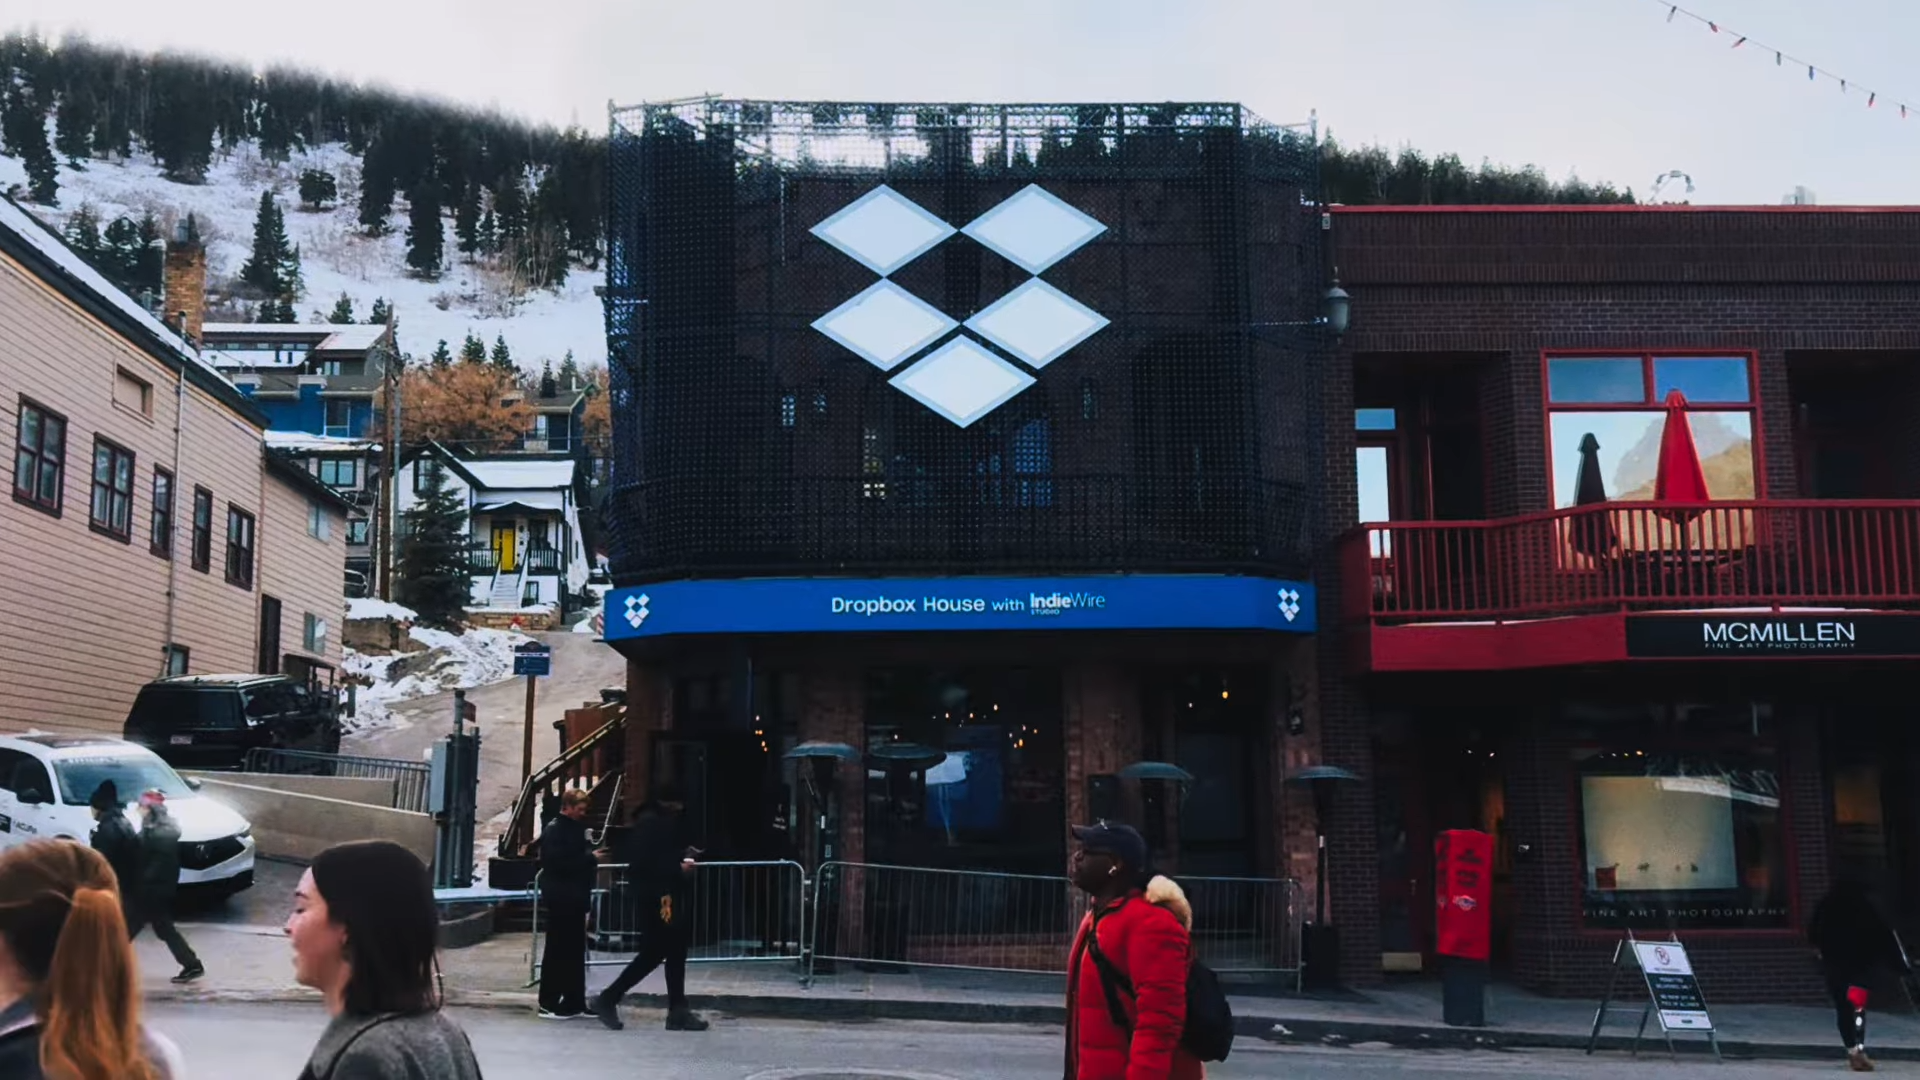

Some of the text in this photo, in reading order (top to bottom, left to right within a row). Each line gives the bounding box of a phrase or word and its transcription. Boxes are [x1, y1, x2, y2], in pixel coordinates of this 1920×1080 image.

[831, 592, 1106, 616] Dropbox House with IndieWire
[1703, 622, 1855, 642] MCMILLEN
[1583, 908, 1788, 918] FINE ART PHOTOGRAPHY
